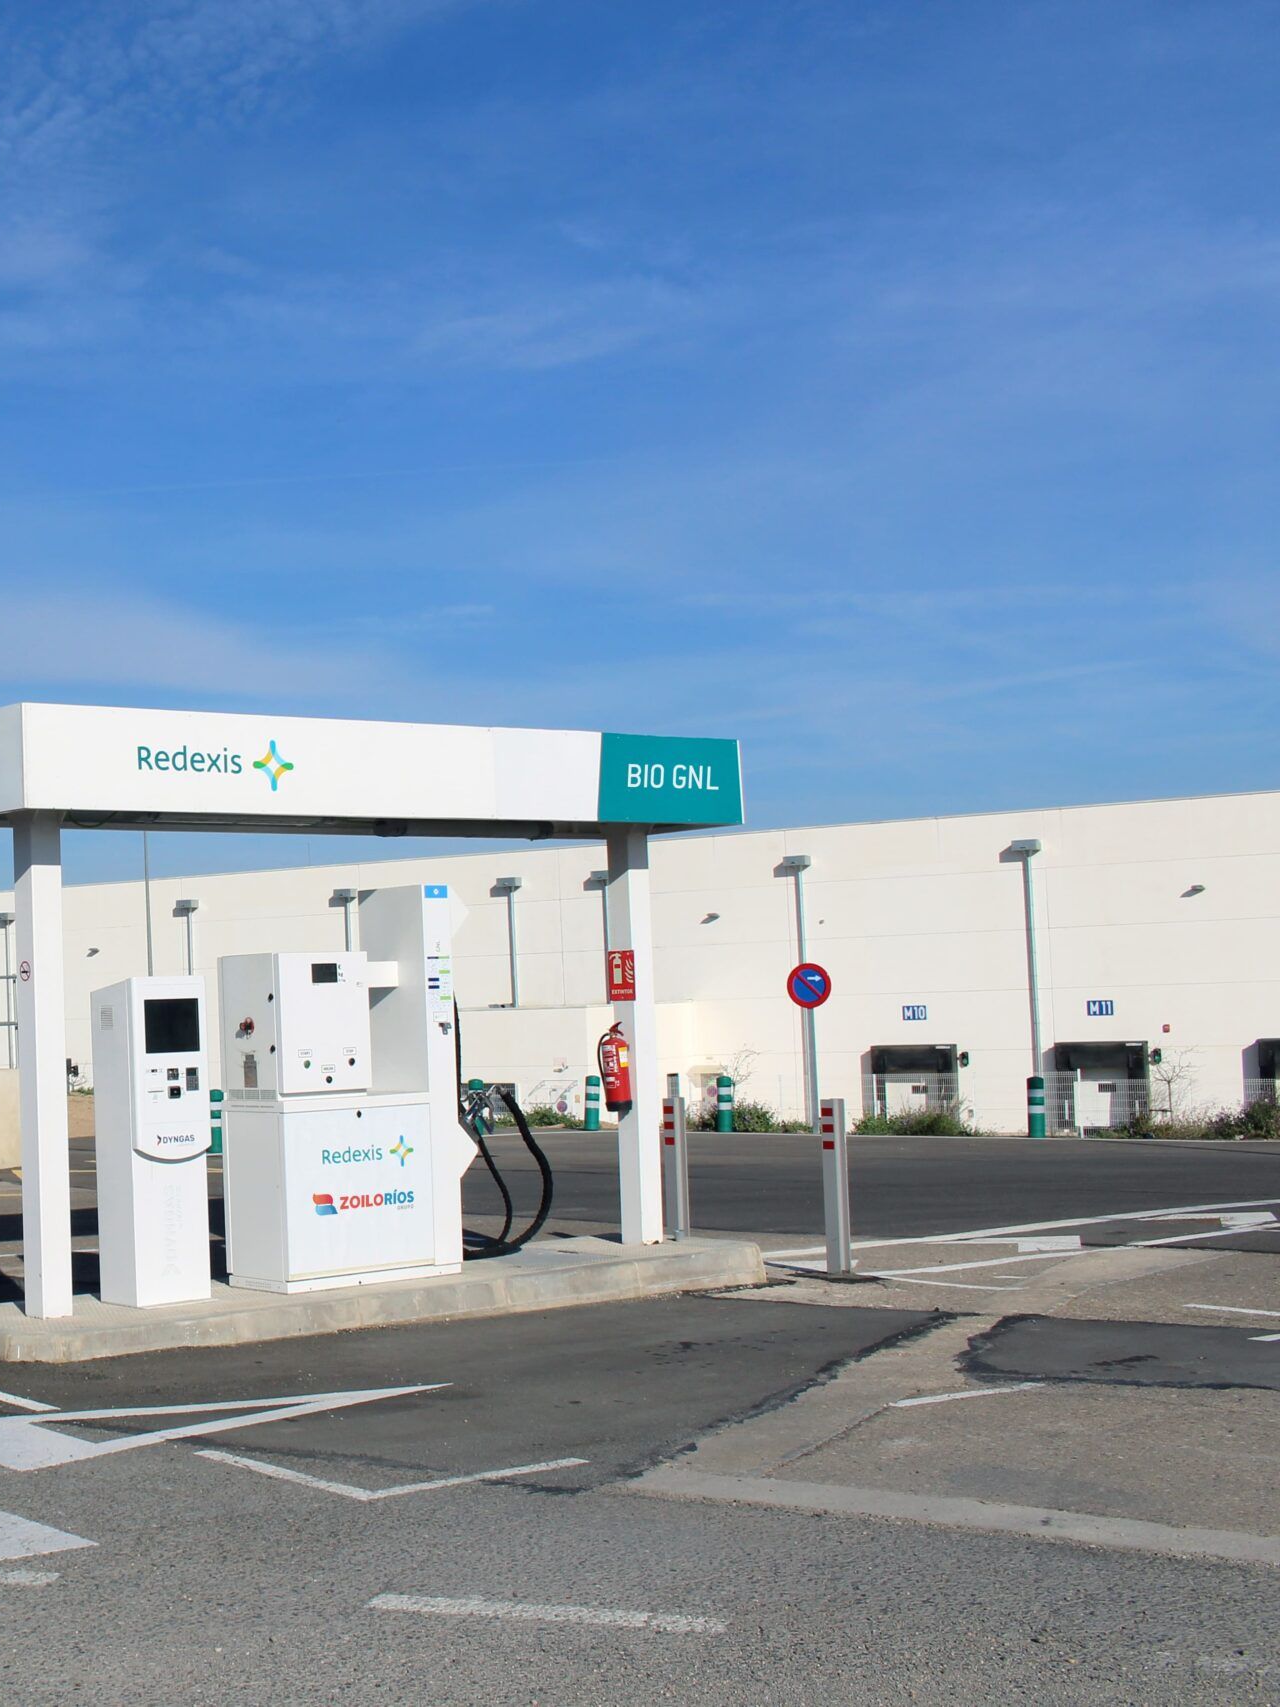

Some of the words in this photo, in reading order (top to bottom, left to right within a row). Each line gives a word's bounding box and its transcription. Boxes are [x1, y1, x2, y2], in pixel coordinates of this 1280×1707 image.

[137, 745, 242, 774] Redexis
[627, 764, 665, 789] BIO
[672, 764, 720, 791] GNL
[904, 1006, 925, 1020] M10
[162, 1134, 195, 1144] DYNGAS
[321, 1144, 383, 1165] Redexis
